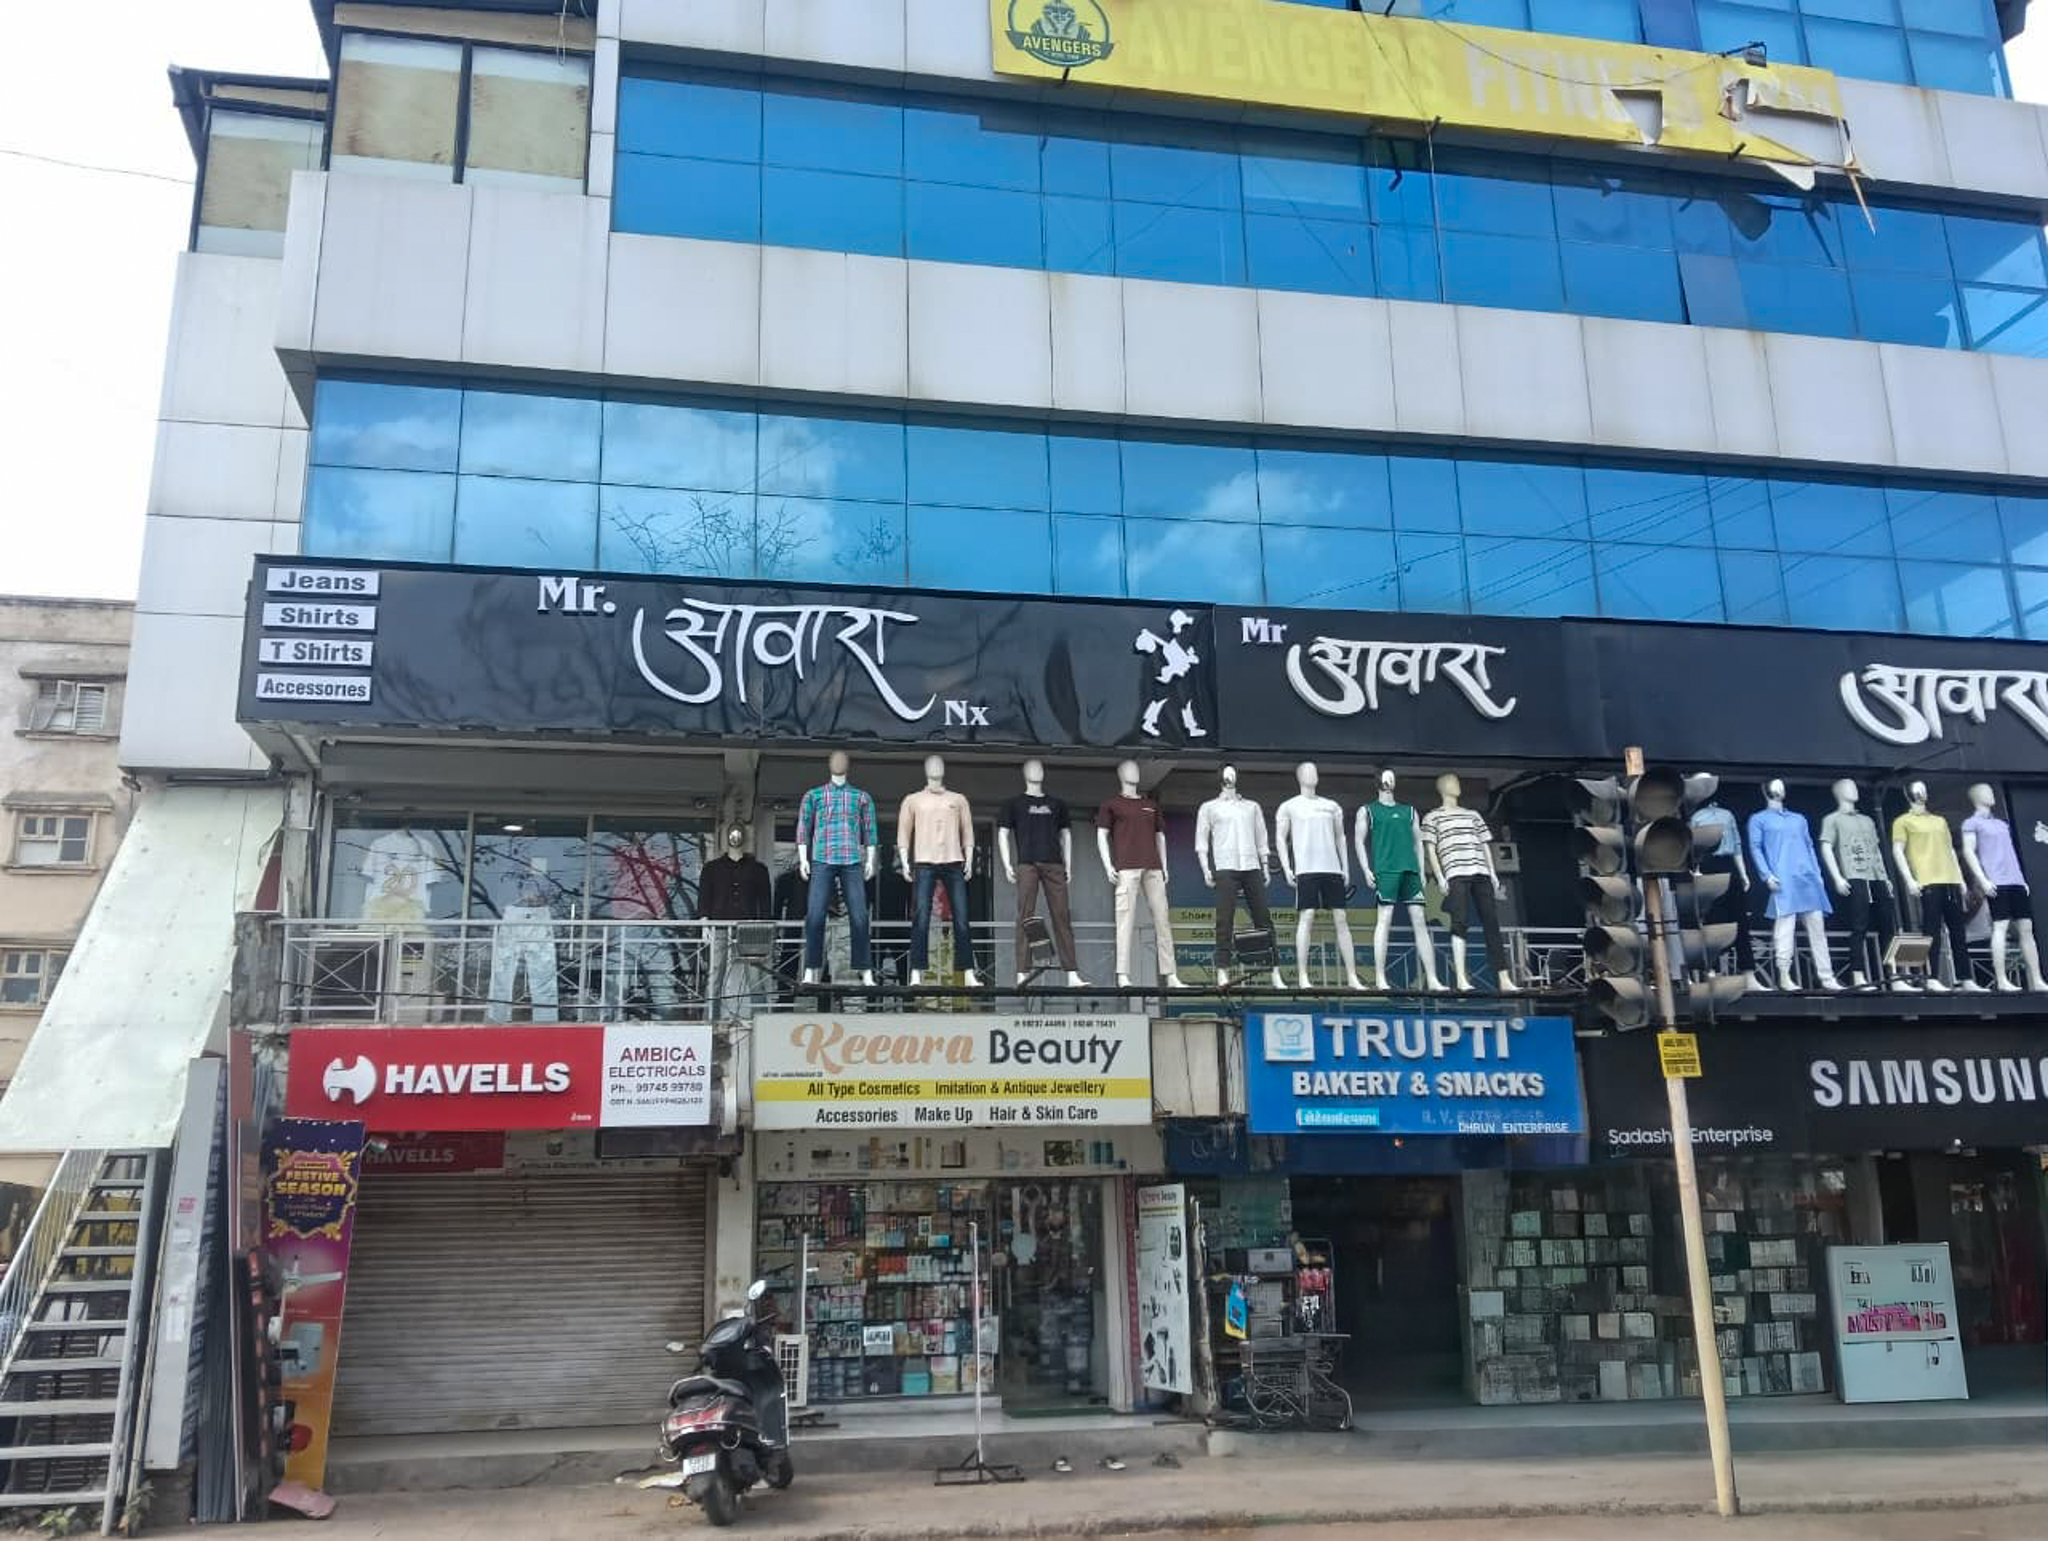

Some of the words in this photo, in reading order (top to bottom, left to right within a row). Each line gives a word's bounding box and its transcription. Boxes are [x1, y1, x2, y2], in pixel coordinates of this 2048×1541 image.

[1023, 36, 1102, 57] AVENGERS
[281, 571, 366, 591] Jeans
[280, 607, 359, 626] Shirts
[1241, 617, 1288, 643] Mr
[270, 641, 285, 660] T
[293, 642, 363, 662] Shirts
[537, 576, 616, 614] Mr.
[944, 700, 990, 726] Nx
[262, 678, 367, 698] Accessories
[790, 1022, 974, 1074] Keeara
[989, 1029, 1123, 1074] Beauty
[1323, 1017, 1511, 1059] TRUPTI
[620, 1047, 696, 1062] AMBICA
[384, 1062, 570, 1093] HAVELLS
[609, 1065, 706, 1078] ELECTRICALS
[808, 1082, 823, 1095] All
[829, 1083, 855, 1098] Type
[859, 1081, 920, 1096] Cosmetics
[936, 1081, 986, 1095] Imitation
[990, 1081, 999, 1094] &
[1003, 1081, 1047, 1097] Antique
[1051, 1080, 1105, 1096] Jewellery
[1293, 1071, 1401, 1096] BAKERY
[1410, 1072, 1430, 1096] &
[1436, 1072, 1545, 1097] SNACKS
[1810, 1058, 2048, 1107] SAMSUN
[816, 1108, 898, 1123] Accessories
[915, 1107, 950, 1121] Make
[955, 1107, 973, 1123] Up
[989, 1106, 1016, 1121] Hair
[1022, 1106, 1031, 1120] &
[1036, 1105, 1063, 1120] Skin
[1068, 1106, 1098, 1120] Care
[1458, 1122, 1495, 1134] DHRUV
[1502, 1122, 1569, 1134] ENTERPRISE
[1608, 1127, 1674, 1145] Sadash
[1691, 1125, 1773, 1147] Enterprise
[286, 1170, 340, 1181] FESTIVE
[275, 1182, 347, 1196] SEASON
